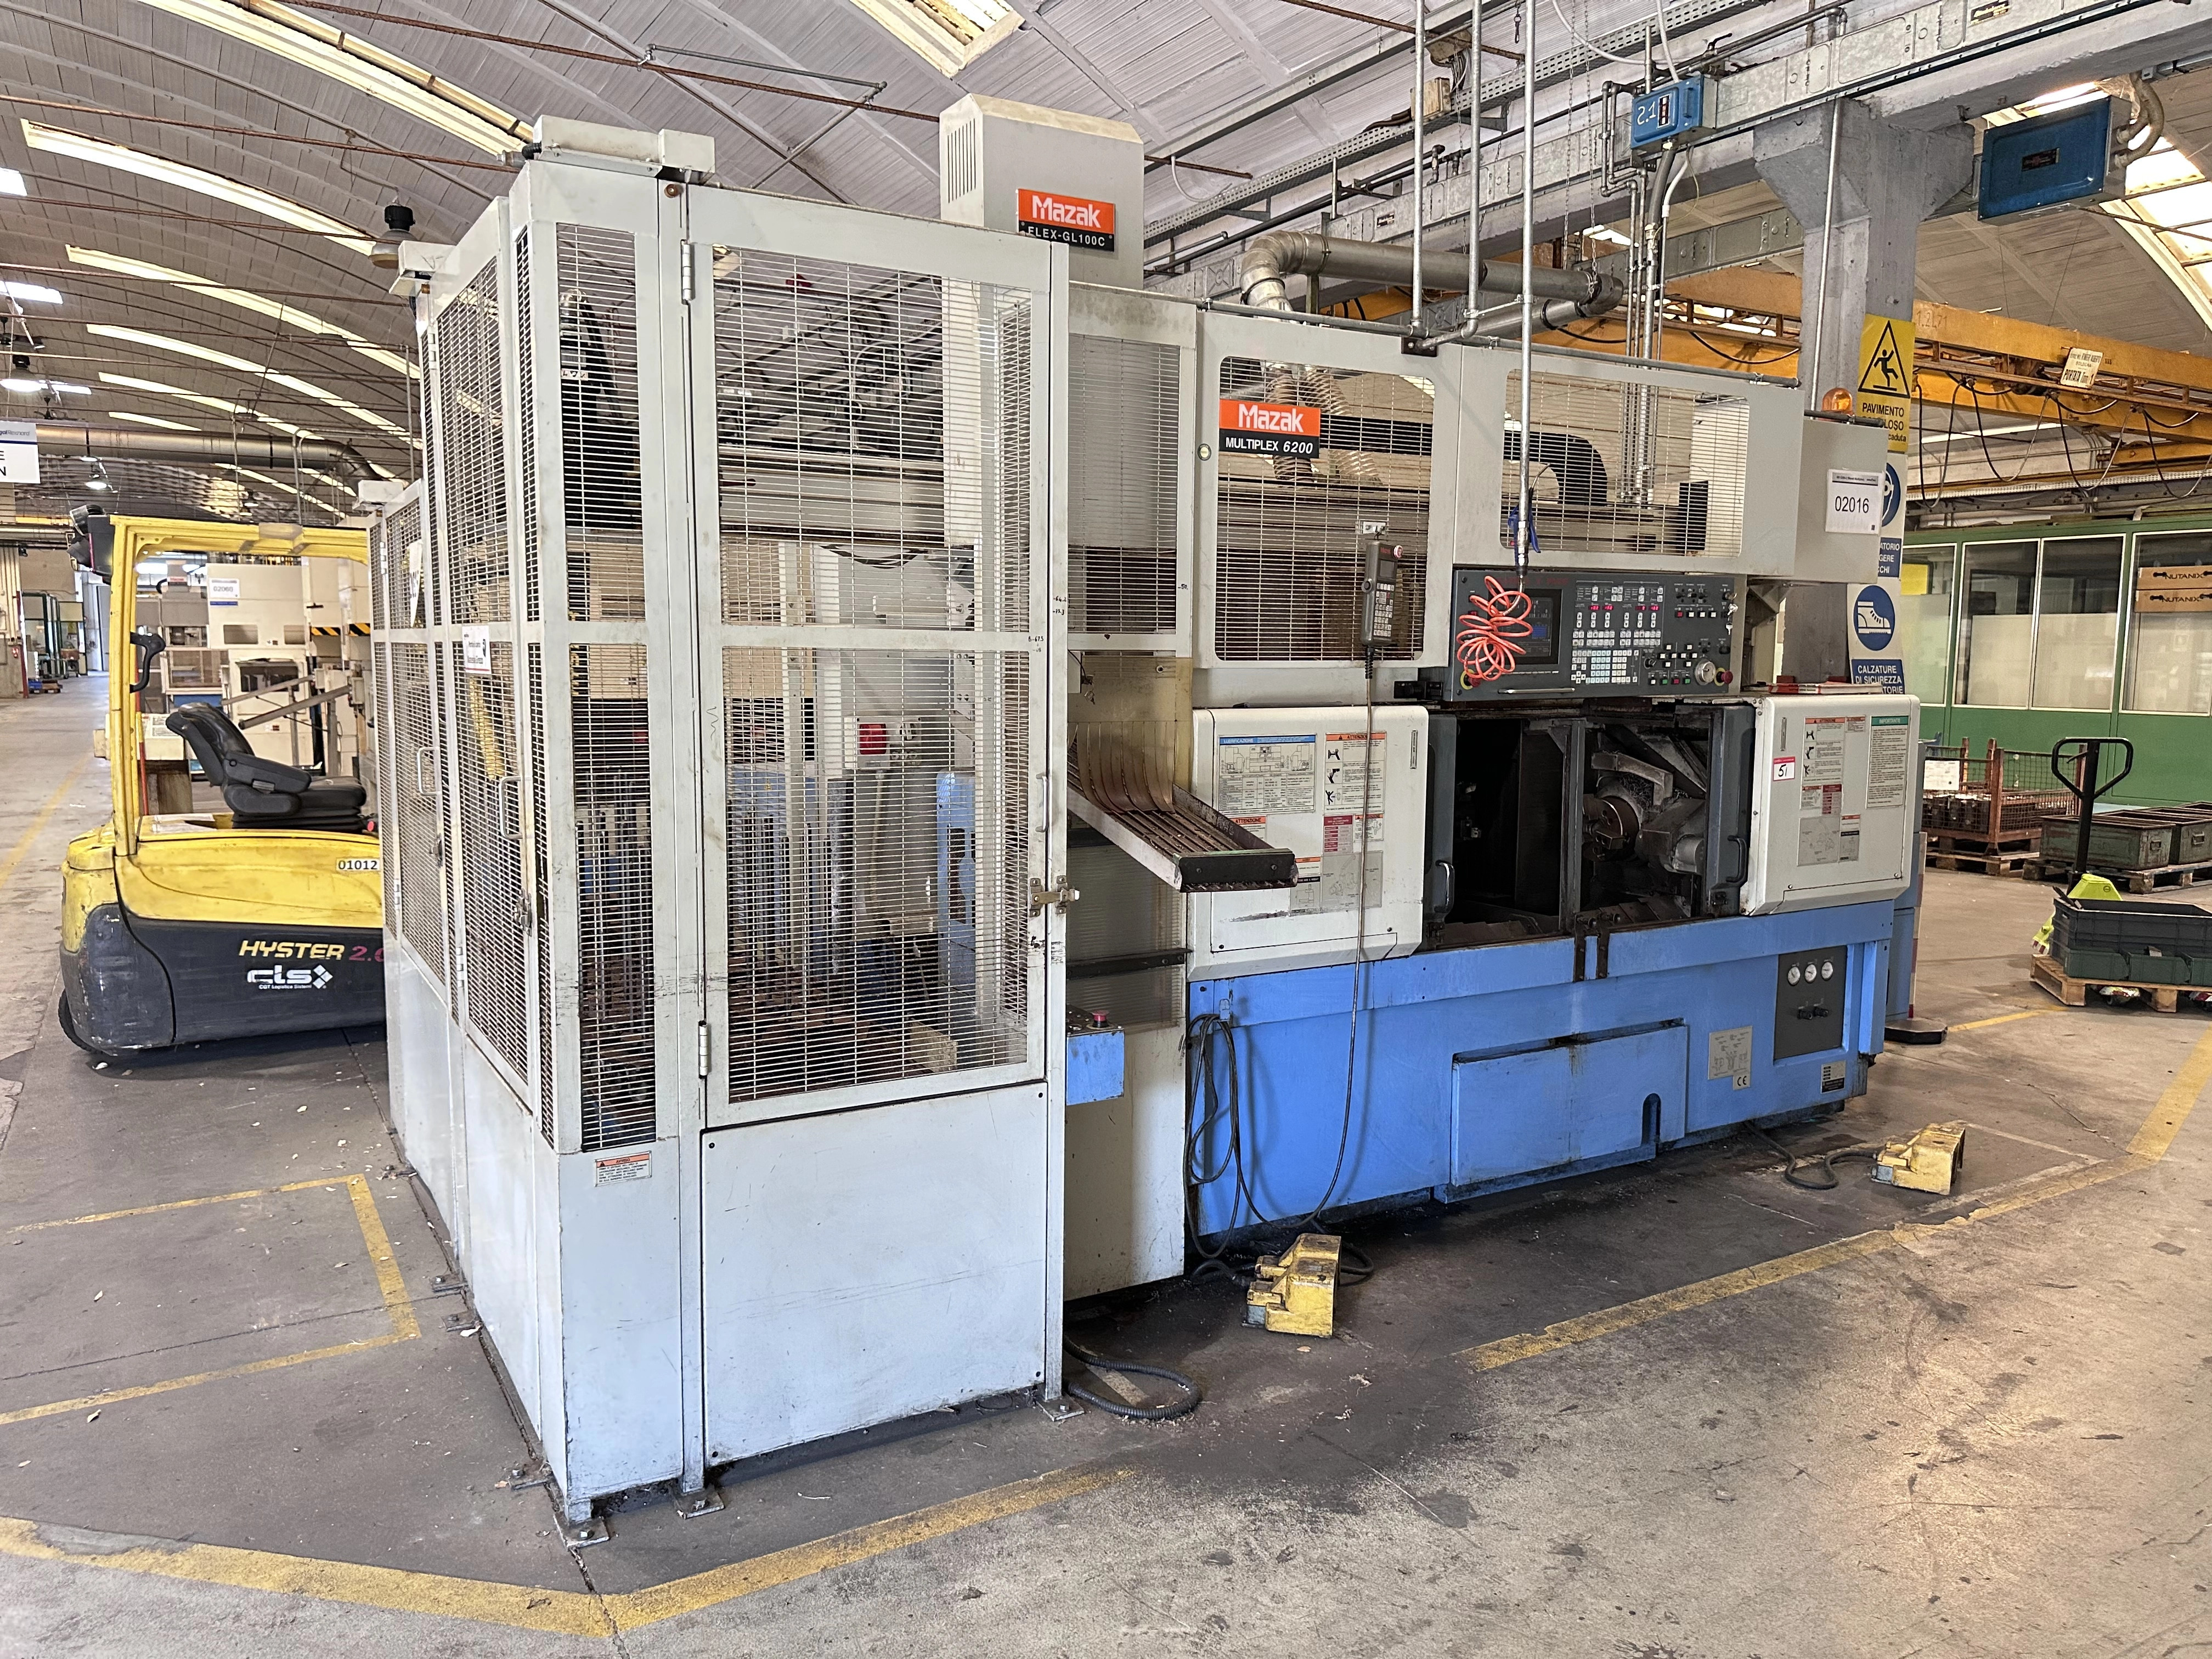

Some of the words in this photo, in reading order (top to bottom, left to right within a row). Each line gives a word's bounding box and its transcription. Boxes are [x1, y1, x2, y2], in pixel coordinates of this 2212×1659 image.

[1637, 101, 1656, 125] 2.1
[1032, 195, 1101, 228] Mazak
[1028, 226, 1105, 247] FLEX-GL100C
[1862, 402, 1904, 417] PAVIMENTO
[1238, 403, 1304, 433] Mazak
[1226, 437, 1279, 452] MULTIPLEX
[1283, 441, 1313, 454] 6200
[1888, 433, 1906, 442] caduta
[1835, 496, 1869, 514] 02016
[1858, 665, 1897, 674] CALZATURE
[1855, 676, 1862, 684] DI
[1864, 675, 1903, 685] SICUREZZA
[1778, 764, 1787, 777] 51
[338, 860, 378, 870] 01012
[239, 940, 345, 960] HYSTER
[1737, 1075, 1747, 1087] CE
